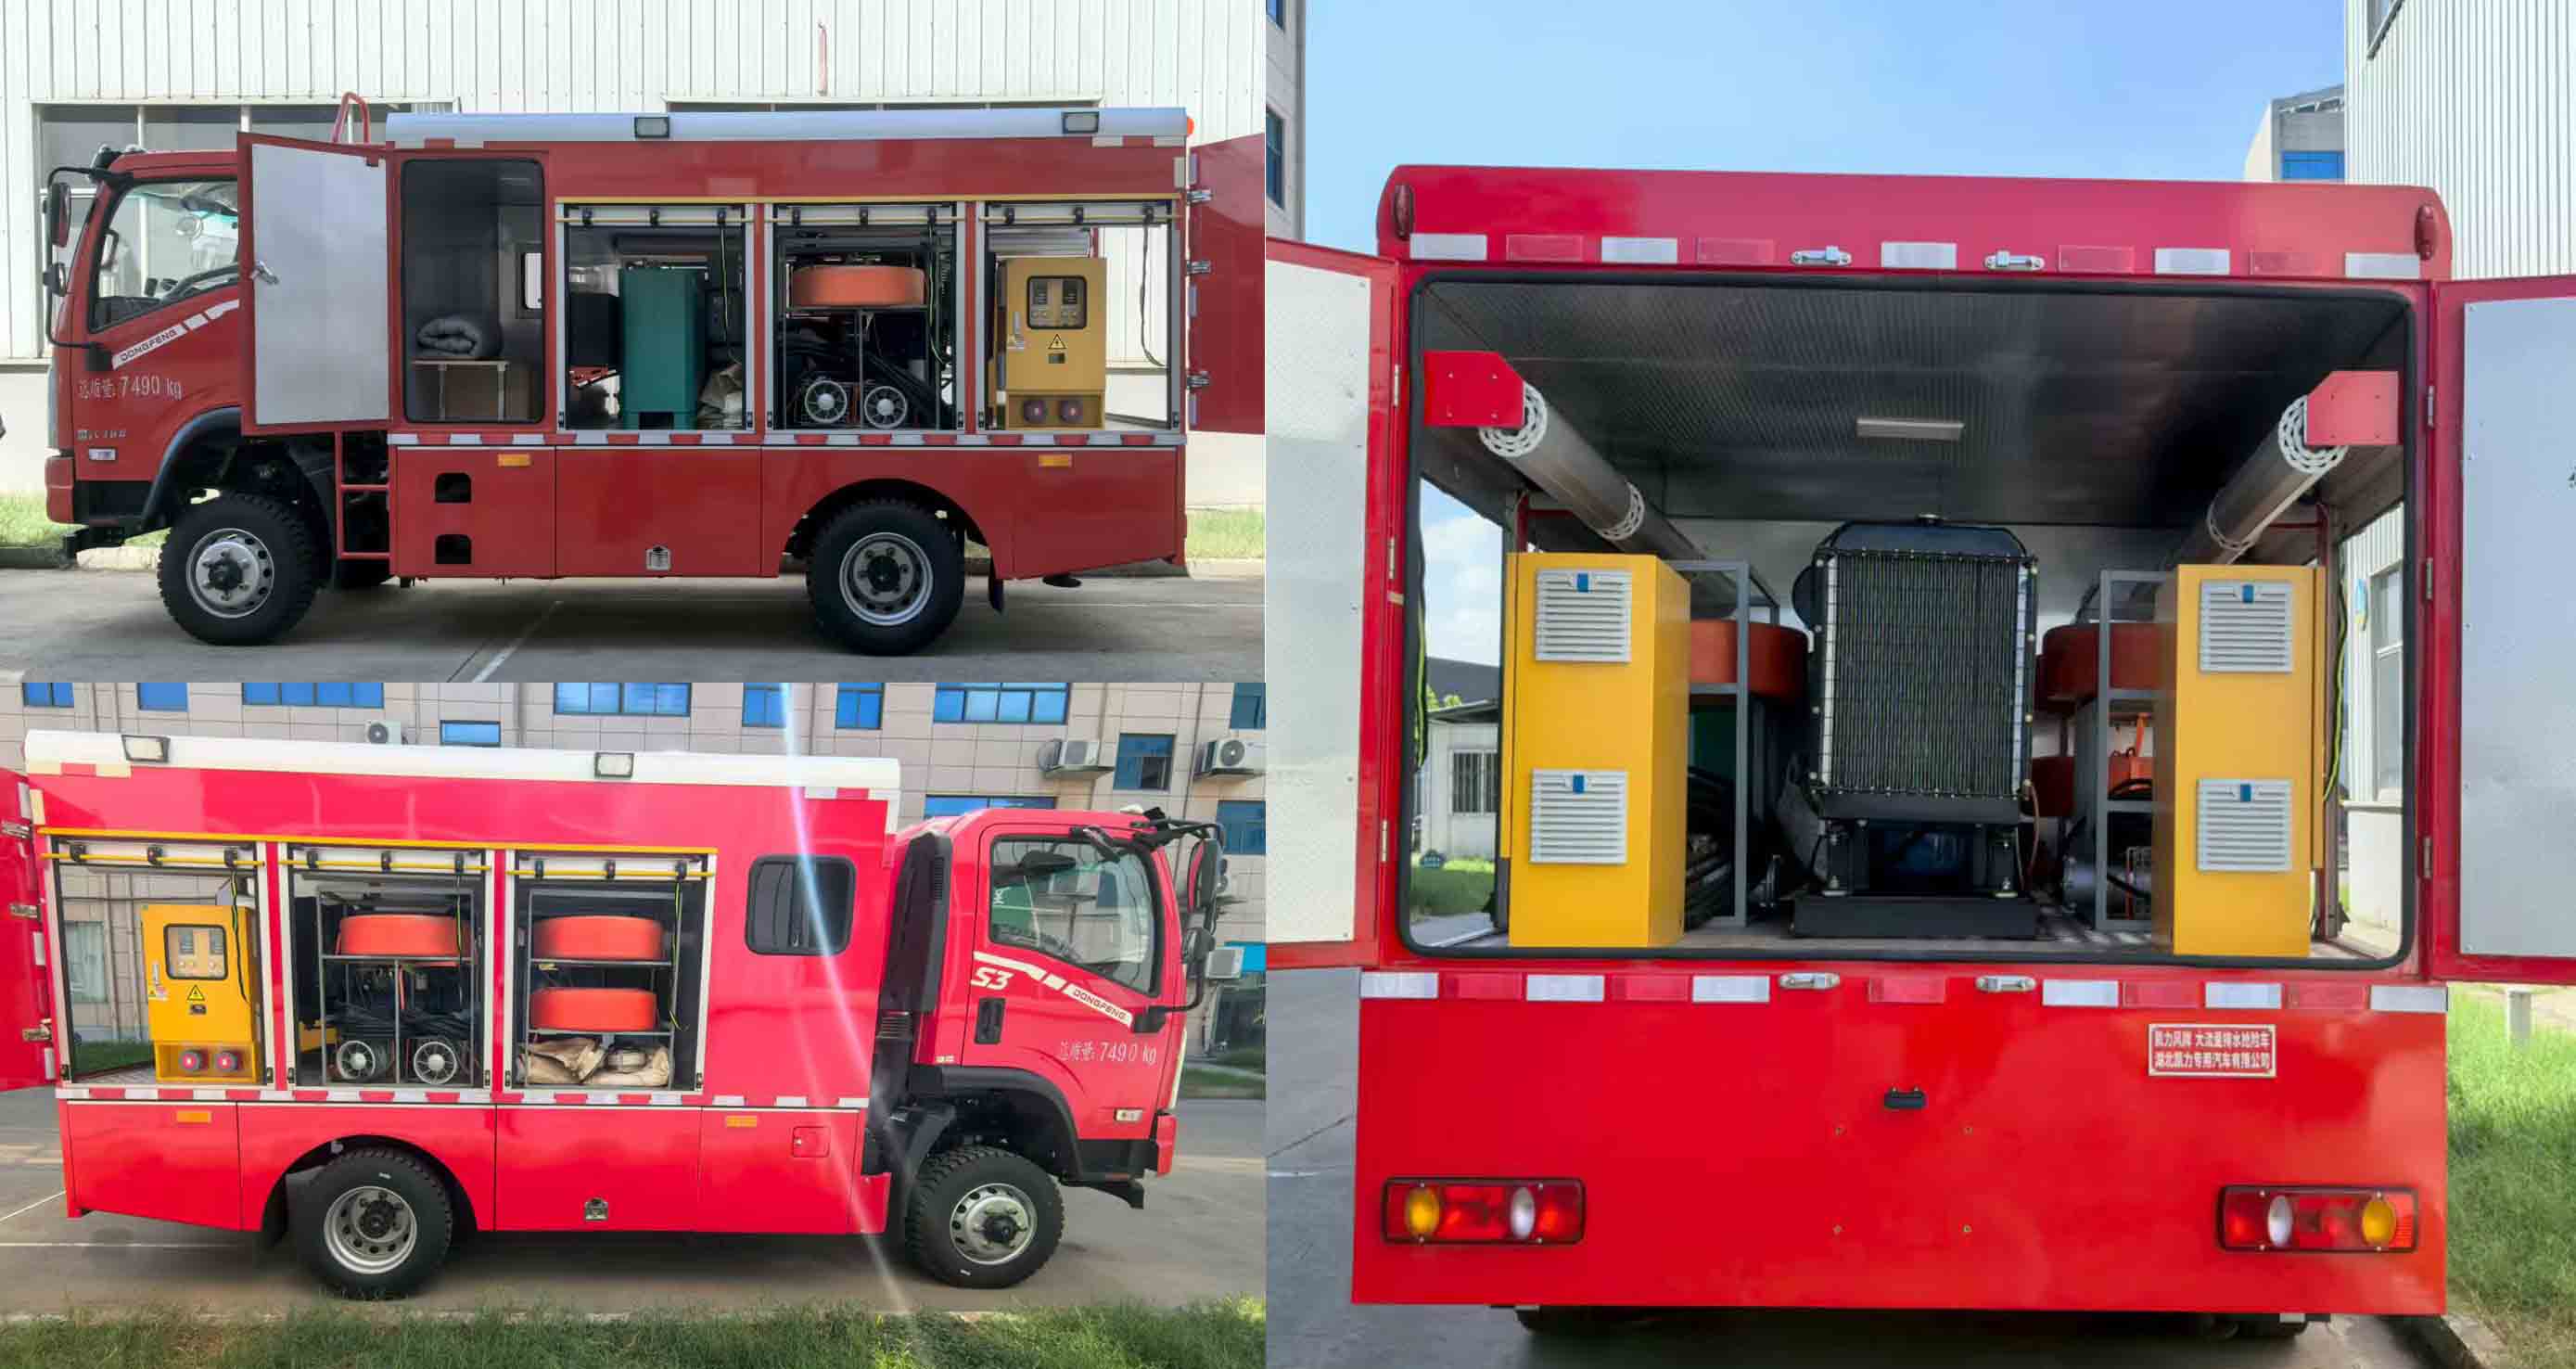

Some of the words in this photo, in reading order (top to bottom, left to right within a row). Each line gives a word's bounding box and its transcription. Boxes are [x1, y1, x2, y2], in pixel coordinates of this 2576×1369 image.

[120, 328, 177, 362] DONGFENG
[120, 376, 160, 398] 7490
[166, 377, 182, 400] kg
[970, 966, 1014, 991] S3
[1073, 989, 1128, 1020] DONGFENG
[1100, 1042, 1138, 1063] 7490
[1142, 1046, 1157, 1067] kg
